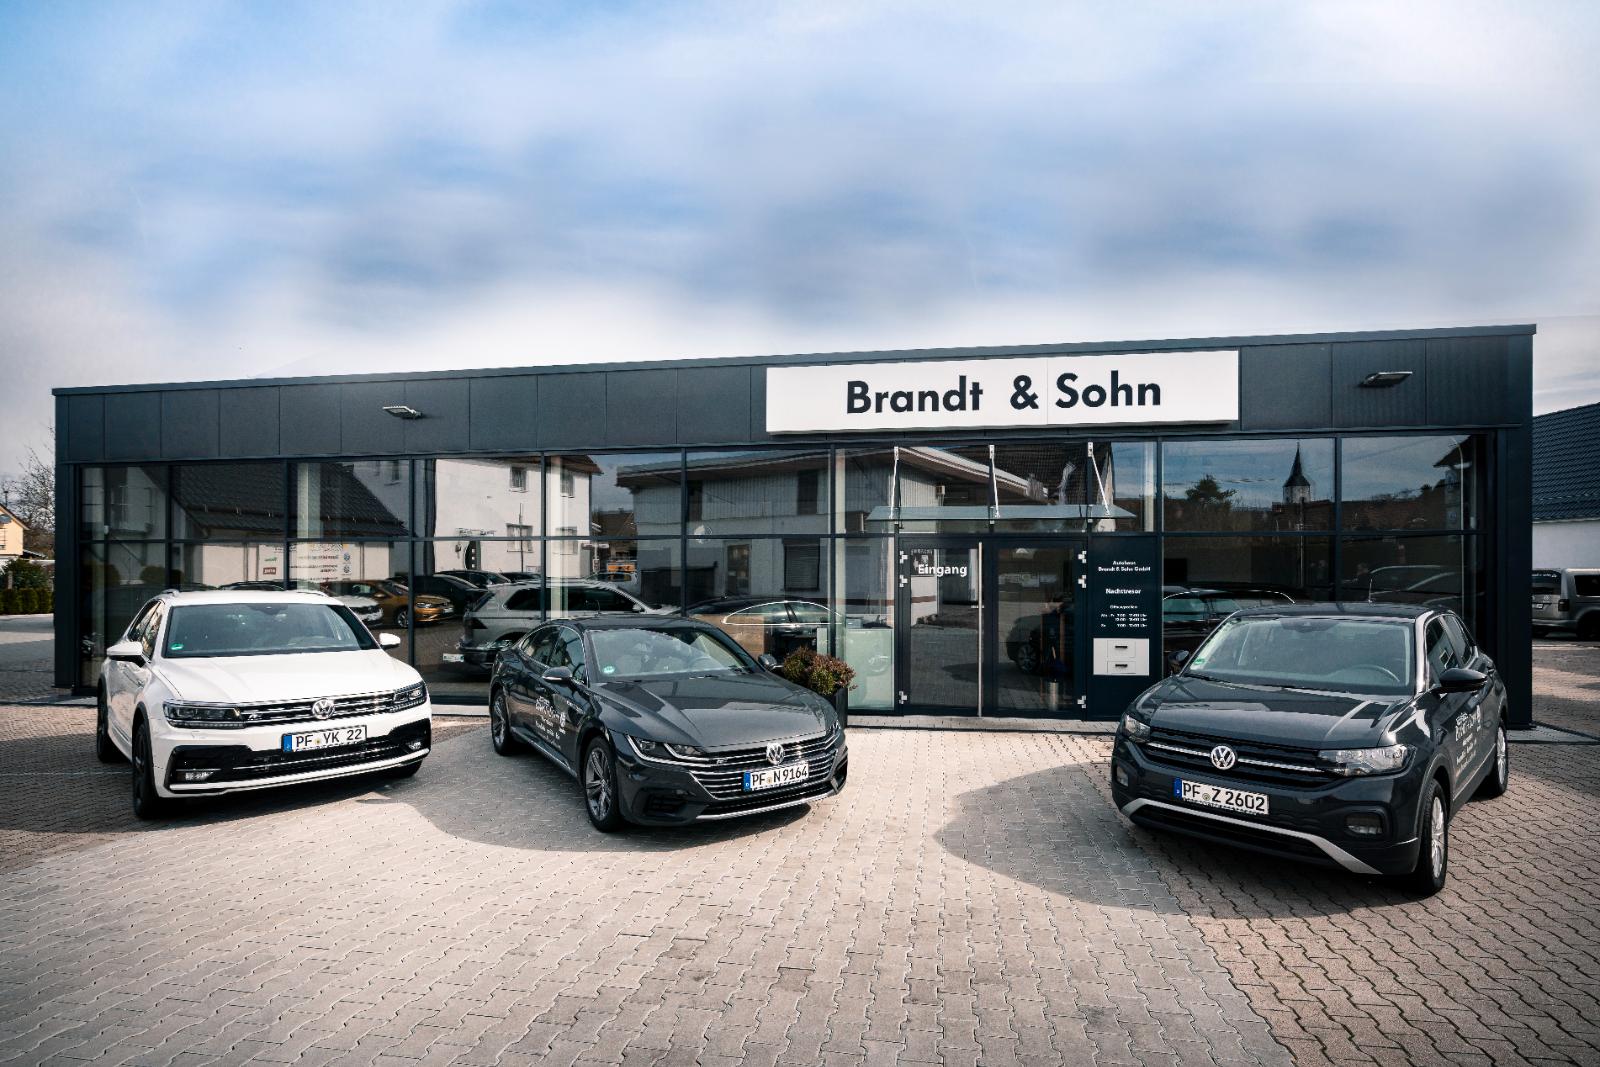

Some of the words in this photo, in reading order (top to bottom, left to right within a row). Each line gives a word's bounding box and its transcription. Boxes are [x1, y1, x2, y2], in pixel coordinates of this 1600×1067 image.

[846, 374, 983, 414] Brandt
[1009, 374, 1039, 410] &
[1055, 370, 1161, 409] Sohn
[918, 563, 967, 578] Eingang
[295, 734, 314, 747] PF
[323, 731, 340, 744] YK
[346, 728, 362, 741] 22
[751, 772, 767, 786] PF
[773, 770, 781, 783] N
[782, 765, 808, 781] 9164
[1182, 782, 1201, 798] PF
[1211, 787, 1221, 803] Z
[1225, 791, 1265, 812] 2602
